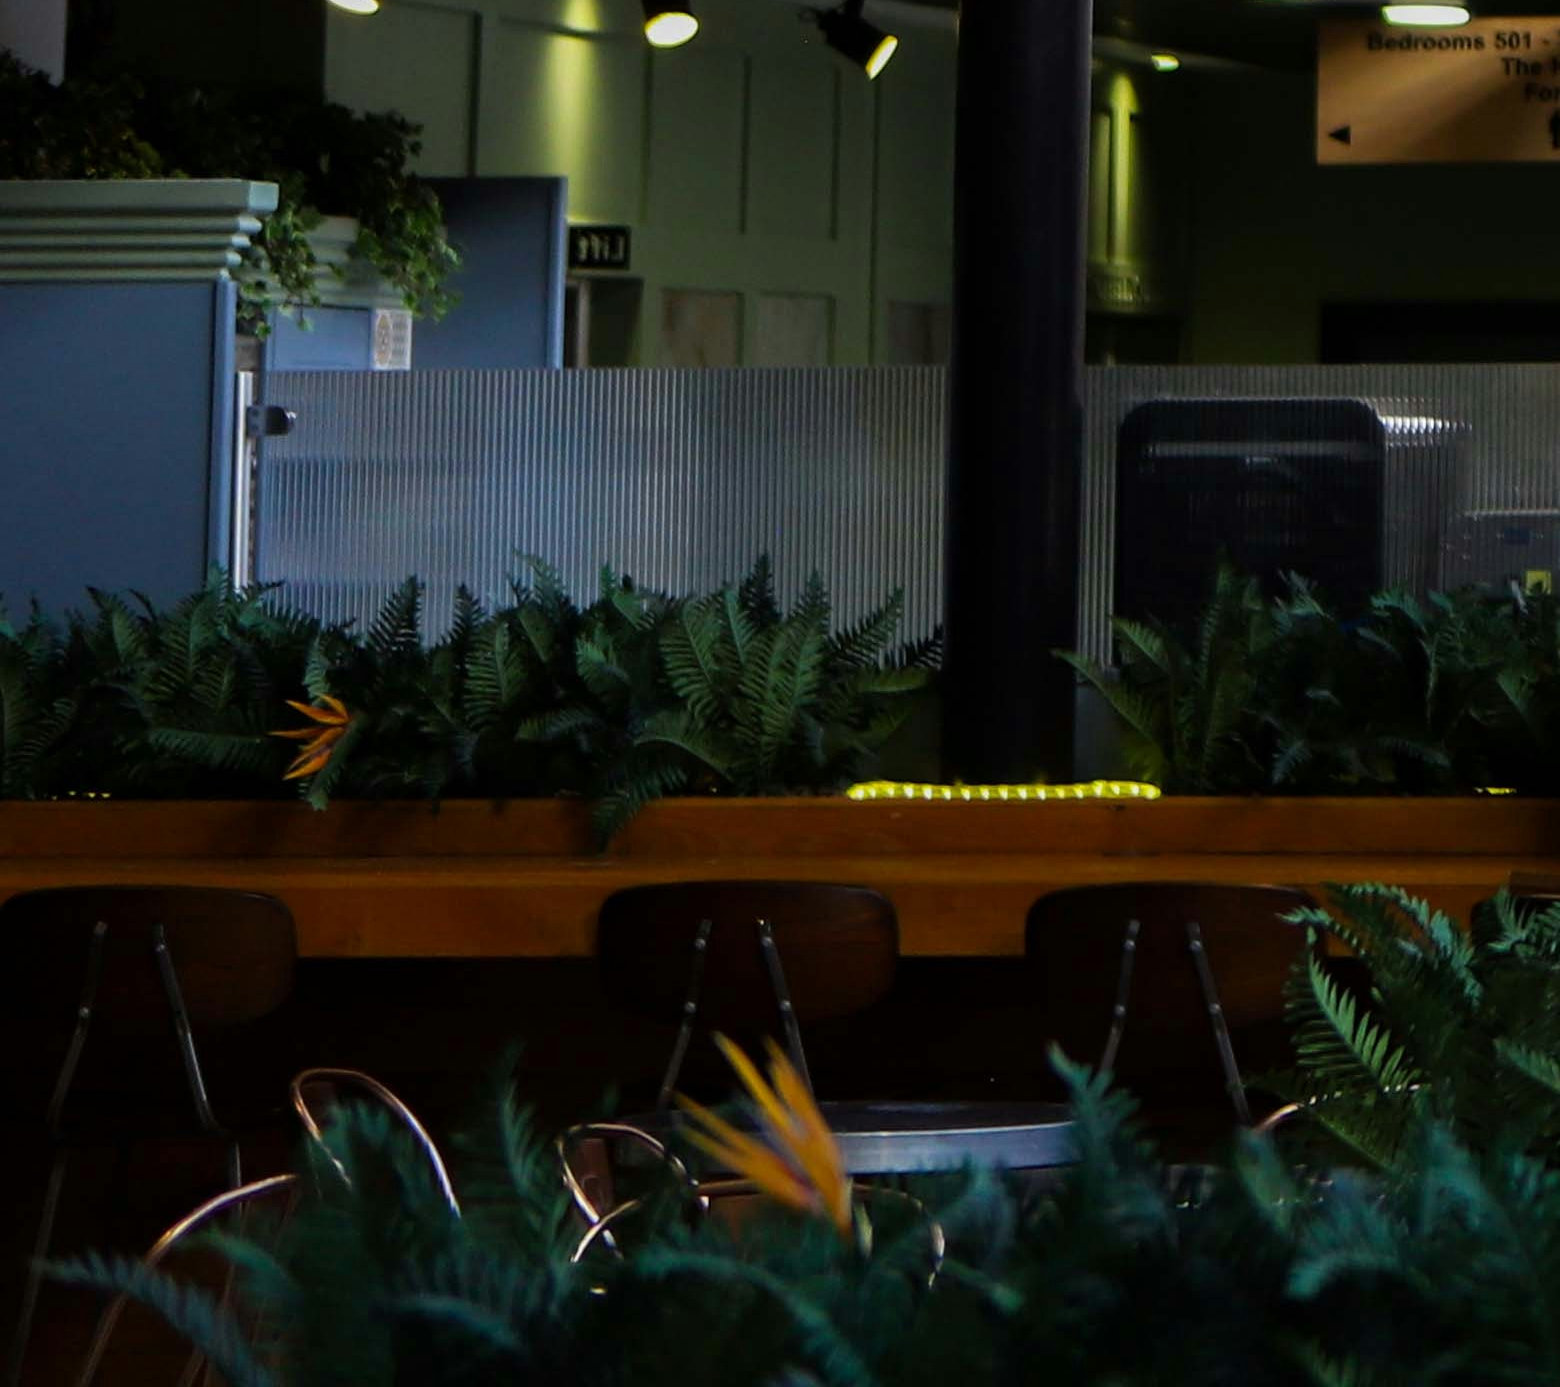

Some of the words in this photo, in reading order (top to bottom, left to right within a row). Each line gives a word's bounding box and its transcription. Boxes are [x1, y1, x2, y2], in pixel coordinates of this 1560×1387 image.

[1367, 33, 1485, 51] Bedrooms
[1494, 32, 1532, 50] 501
[1502, 57, 1543, 76] The
